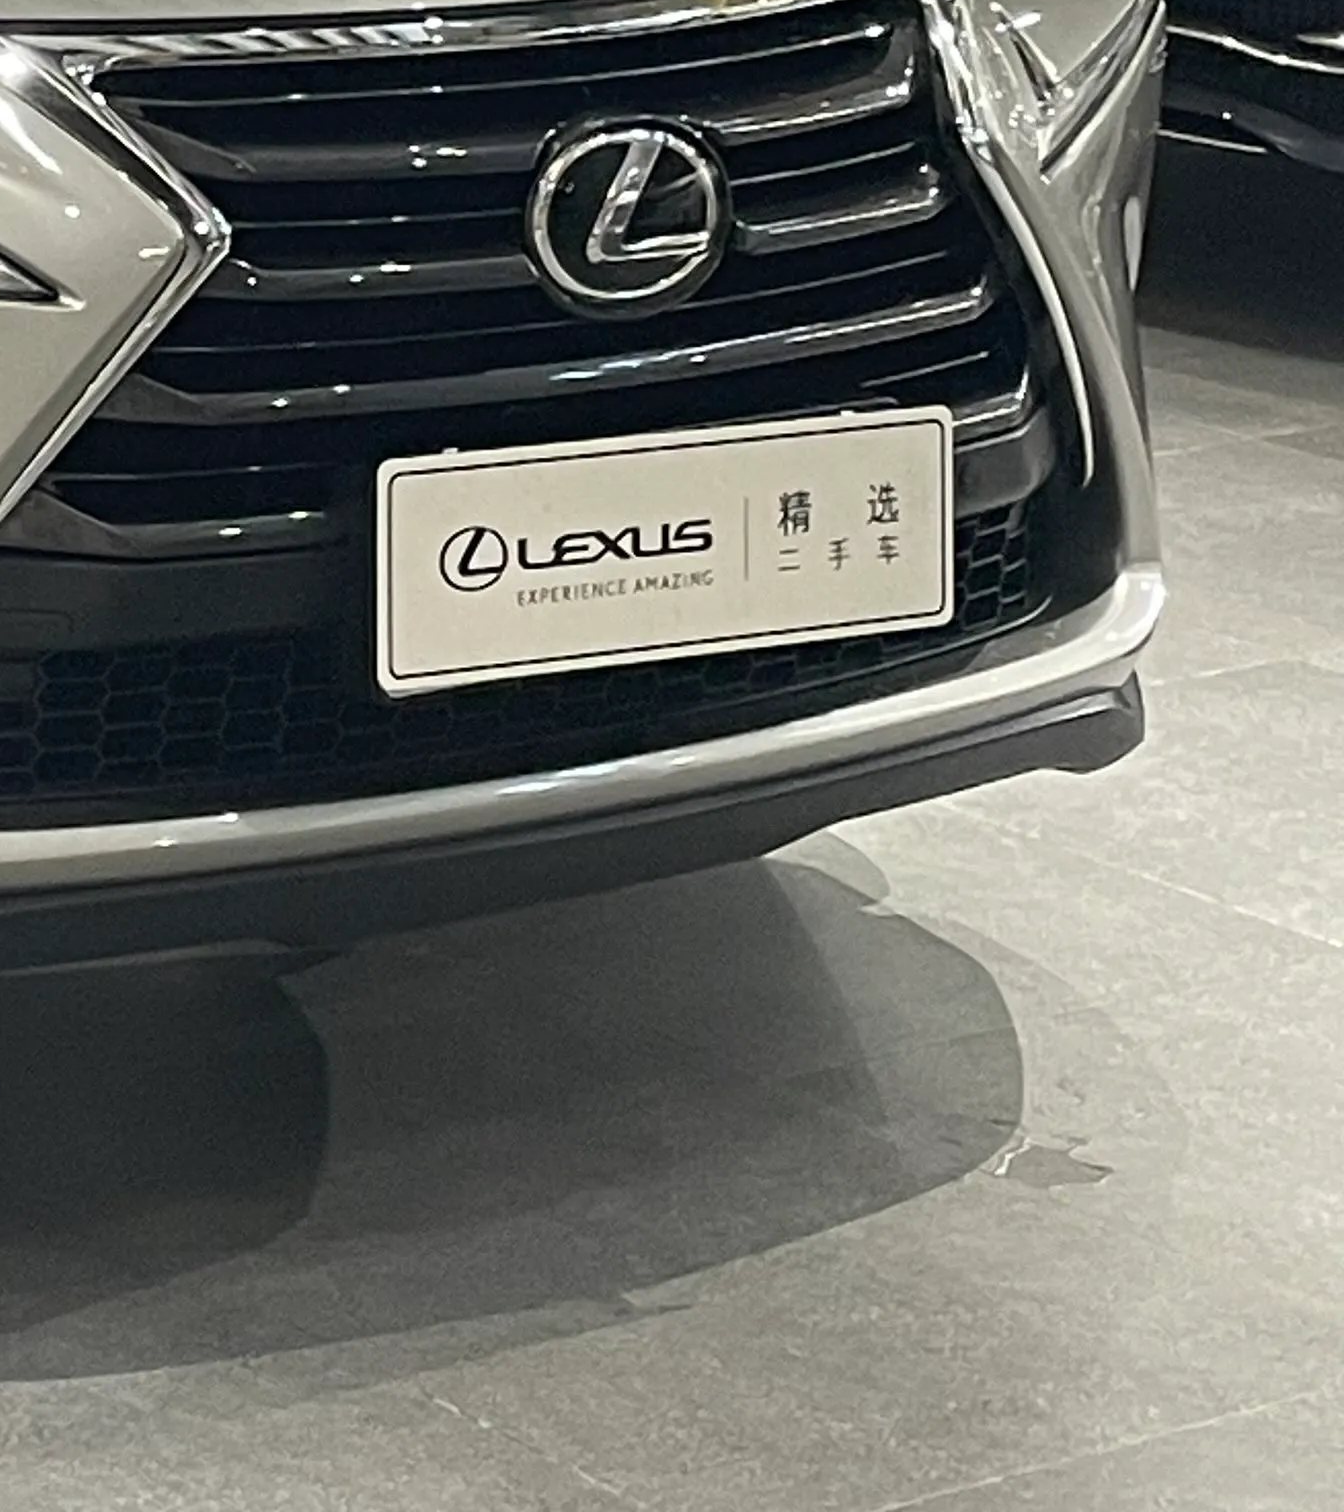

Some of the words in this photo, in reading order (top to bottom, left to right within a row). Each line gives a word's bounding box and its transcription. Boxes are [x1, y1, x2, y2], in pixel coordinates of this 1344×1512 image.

[777, 482, 900, 536] 精选
[517, 519, 713, 570] LEXUS
[778, 535, 900, 572] 二手车
[516, 579, 627, 607] EXPERIENCE
[632, 569, 715, 593] AMAZING
